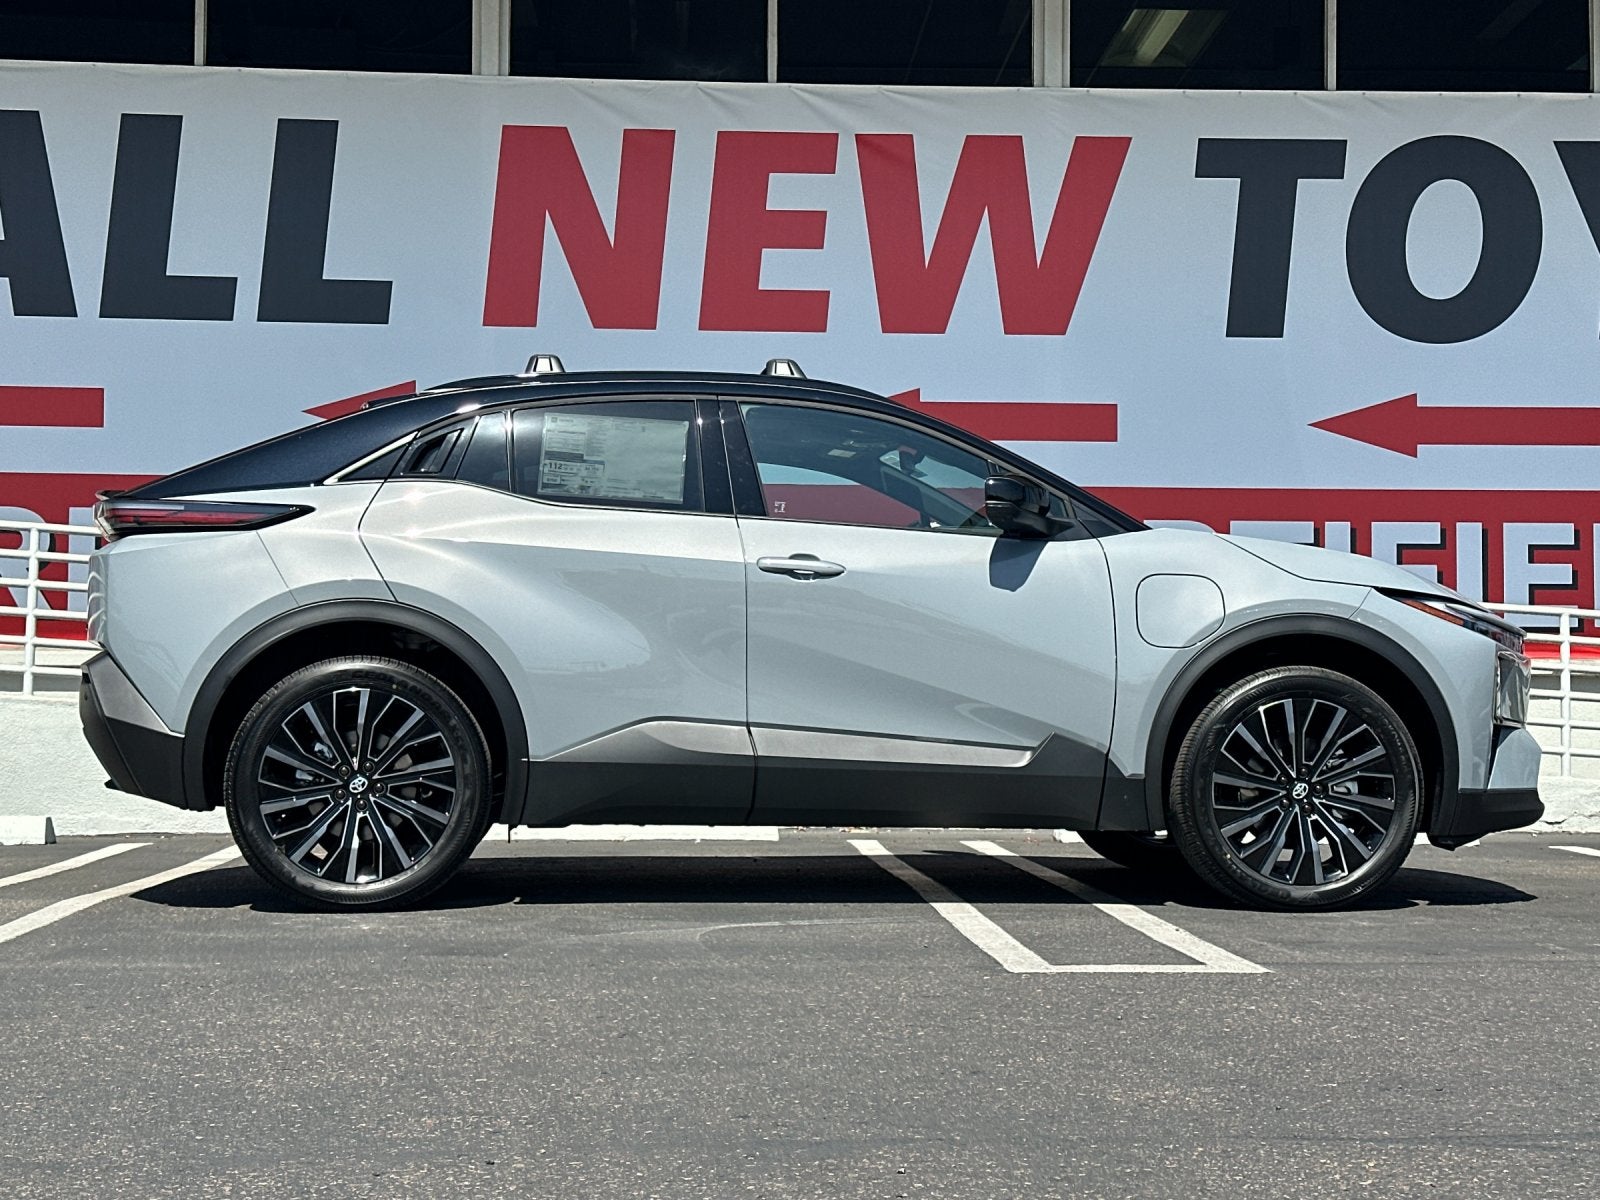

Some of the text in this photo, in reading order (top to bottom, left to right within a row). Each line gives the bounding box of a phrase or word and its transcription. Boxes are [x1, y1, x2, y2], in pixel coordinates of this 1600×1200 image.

[482, 125, 1132, 336] NEW
[1194, 135, 1600, 344] TO
[549, 462, 562, 470] 112
